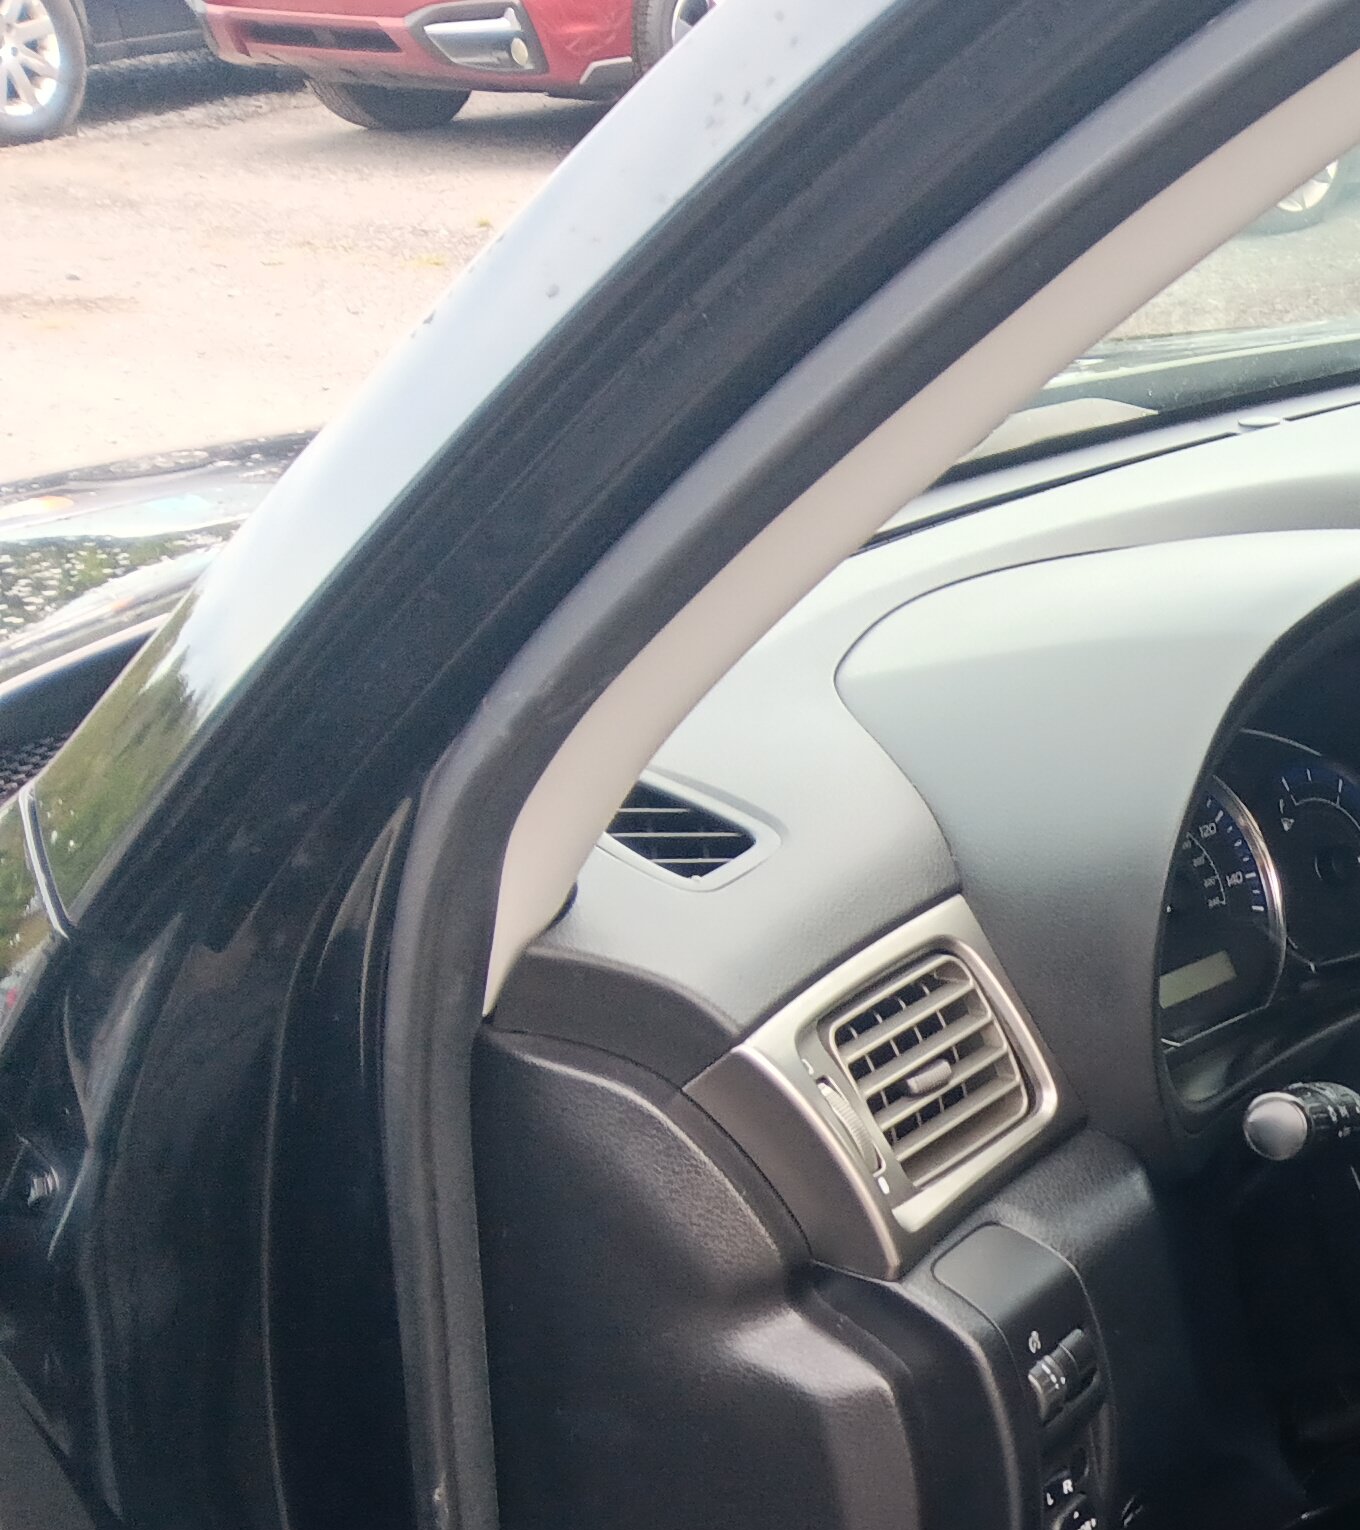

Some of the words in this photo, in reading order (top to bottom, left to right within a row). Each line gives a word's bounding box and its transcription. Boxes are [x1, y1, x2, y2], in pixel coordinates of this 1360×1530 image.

[1199, 822, 1217, 839] 120
[1226, 871, 1243, 887] 140
[1062, 1479, 1074, 1495] R
